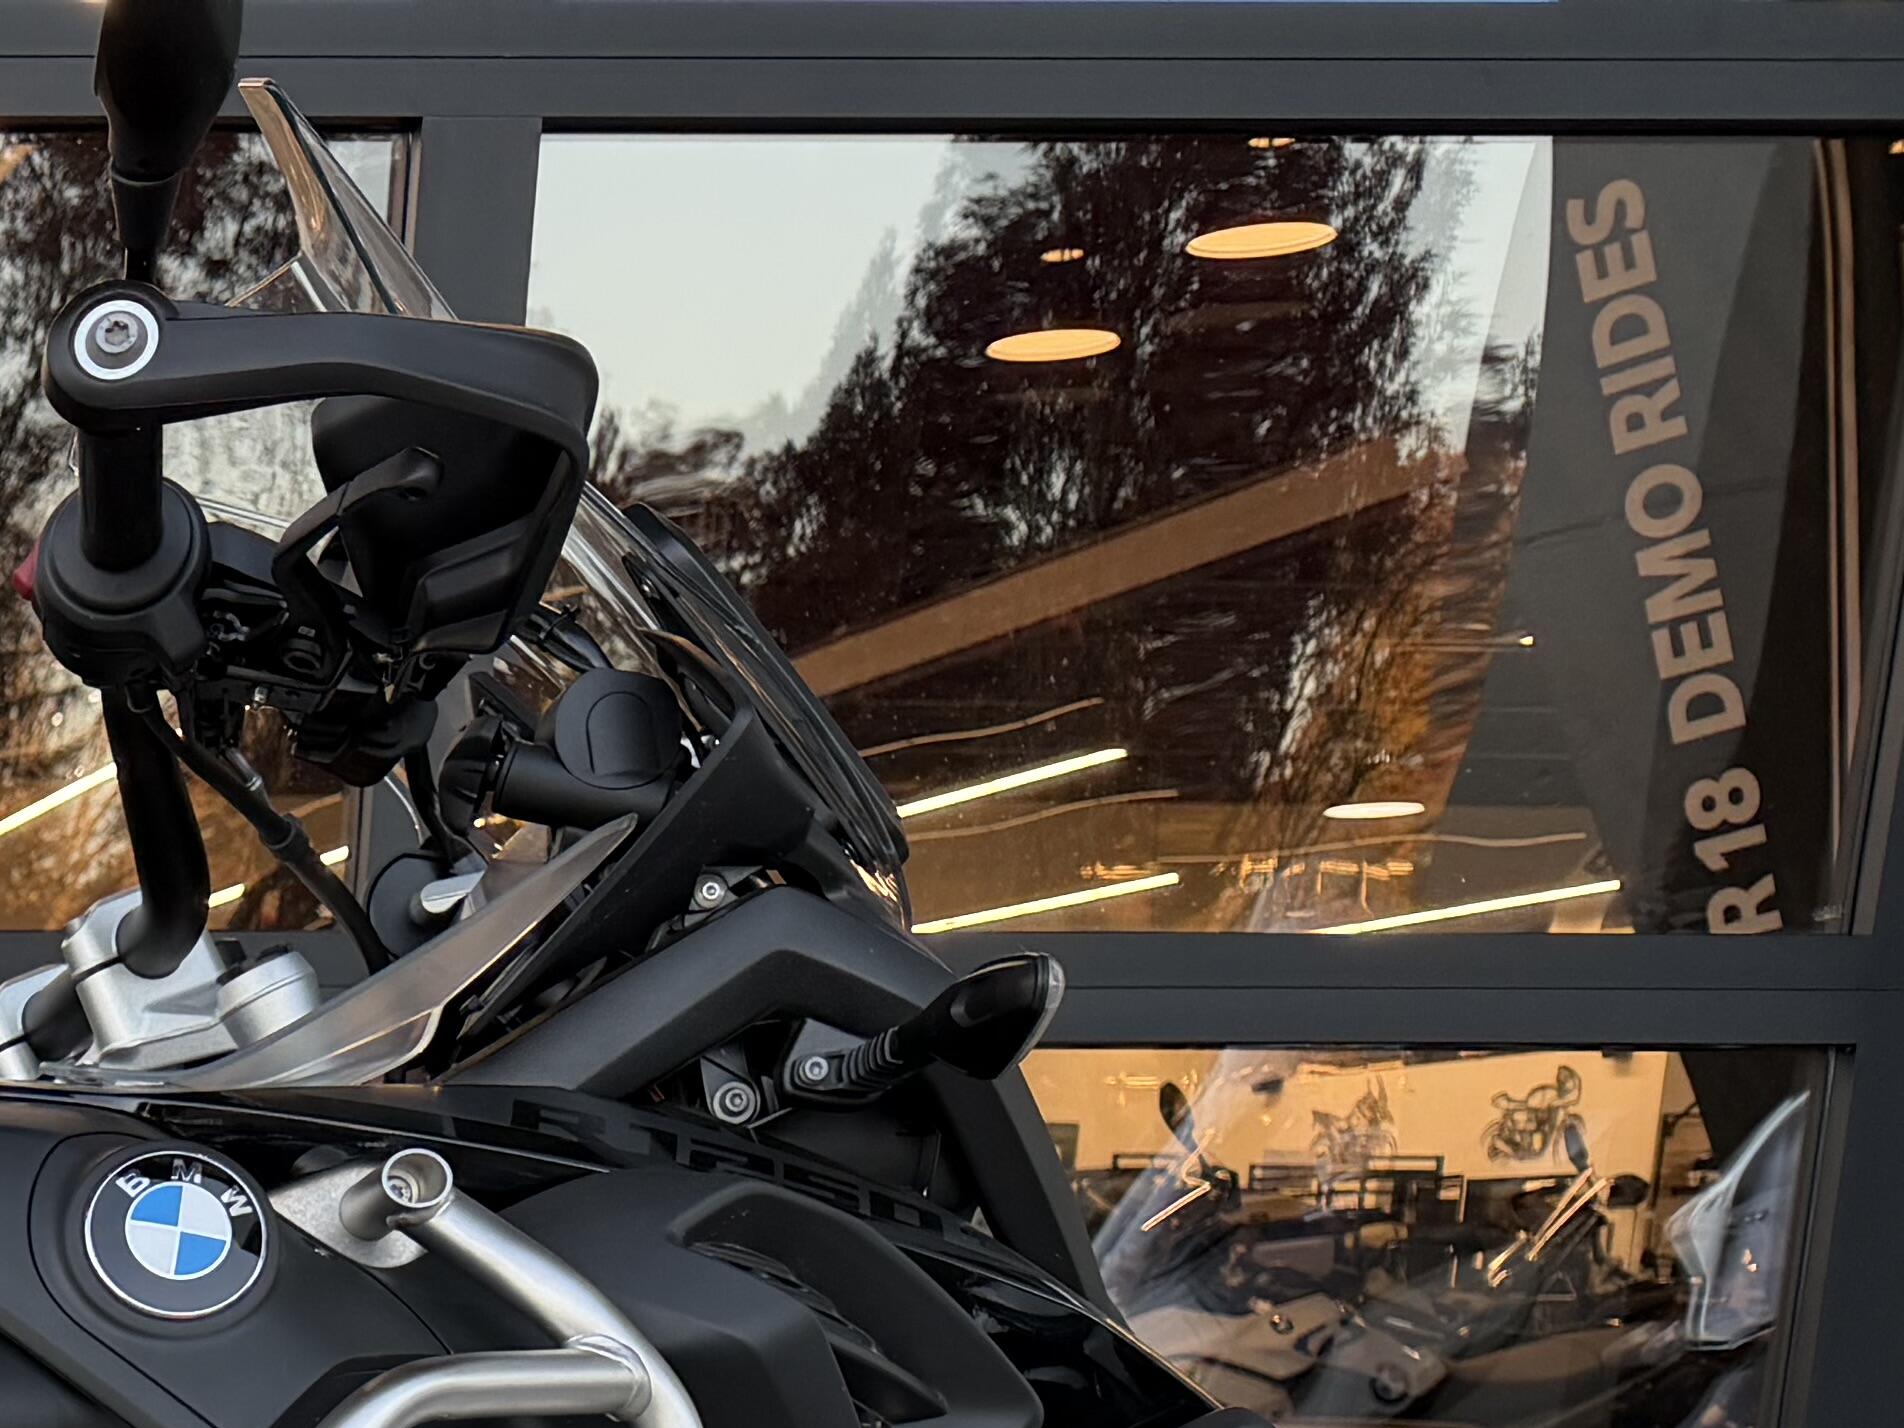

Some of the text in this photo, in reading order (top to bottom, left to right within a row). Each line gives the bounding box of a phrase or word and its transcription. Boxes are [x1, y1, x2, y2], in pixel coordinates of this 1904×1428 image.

[1567, 177, 1689, 455] RIDES
[1624, 463, 1747, 745] DEMO
[115, 1158, 253, 1217] BMW
